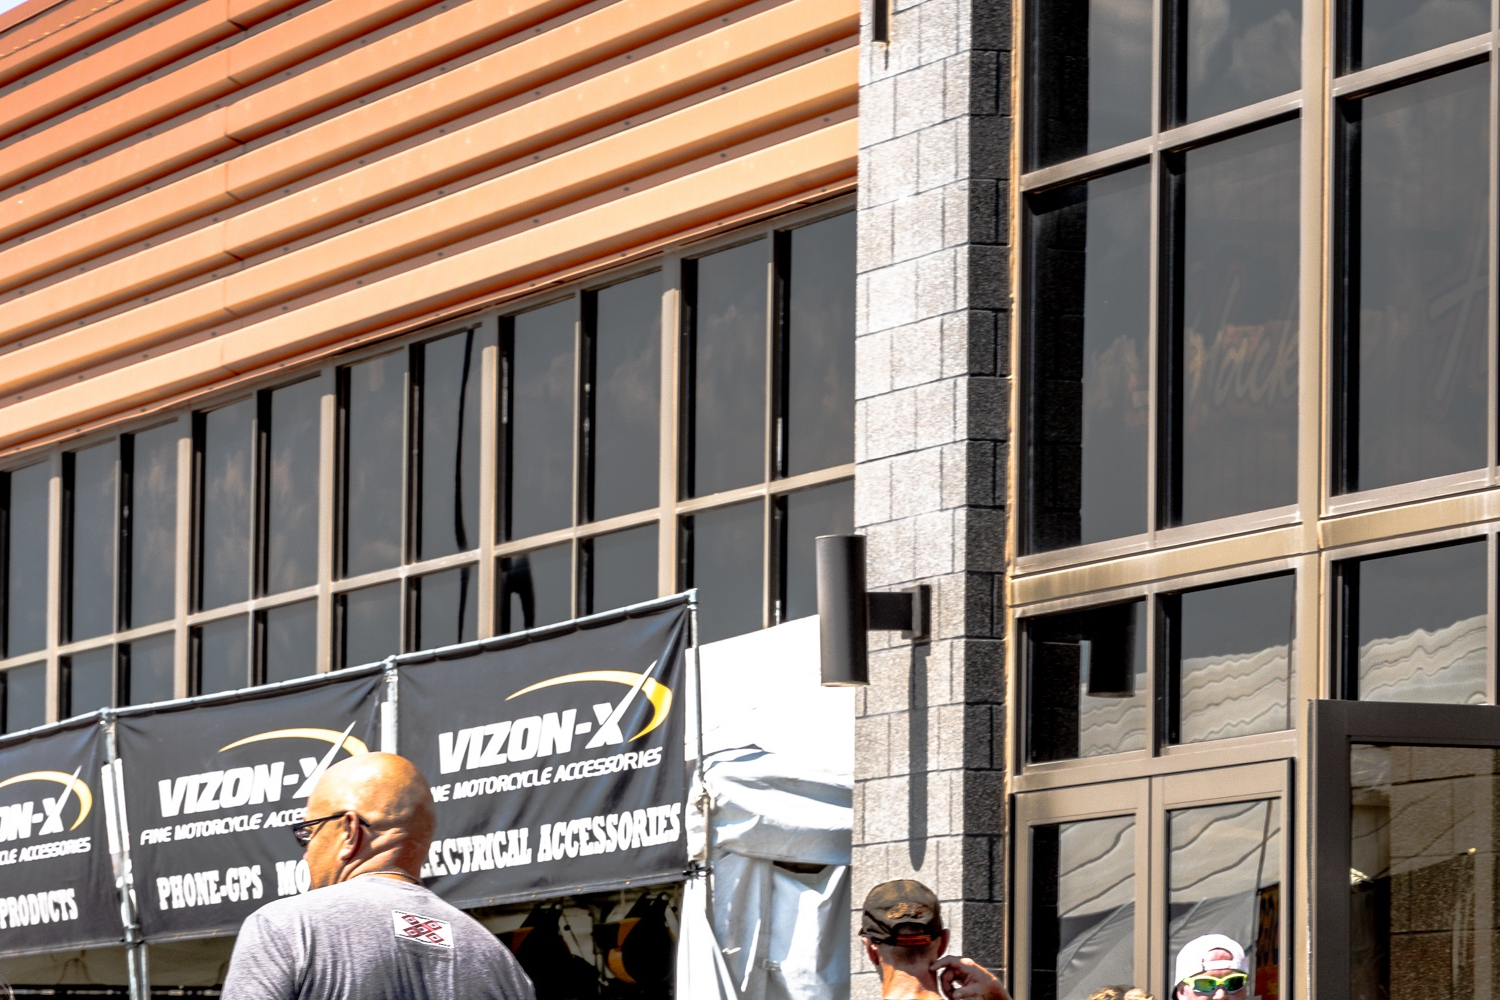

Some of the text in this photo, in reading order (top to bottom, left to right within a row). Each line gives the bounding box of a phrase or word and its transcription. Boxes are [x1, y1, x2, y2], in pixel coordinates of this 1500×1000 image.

[438, 660, 657, 775] VIZON-X
[453, 766, 553, 800] MOTORCYCLE
[554, 746, 663, 784] ACCESSORIES
[18, 837, 91, 862] ACCESSORIES
[140, 826, 173, 846] FINE
[174, 813, 264, 841] MOTORCYCLE
[537, 802, 682, 863] ACCESSORIES
[156, 865, 263, 911] PHONE-GPS
